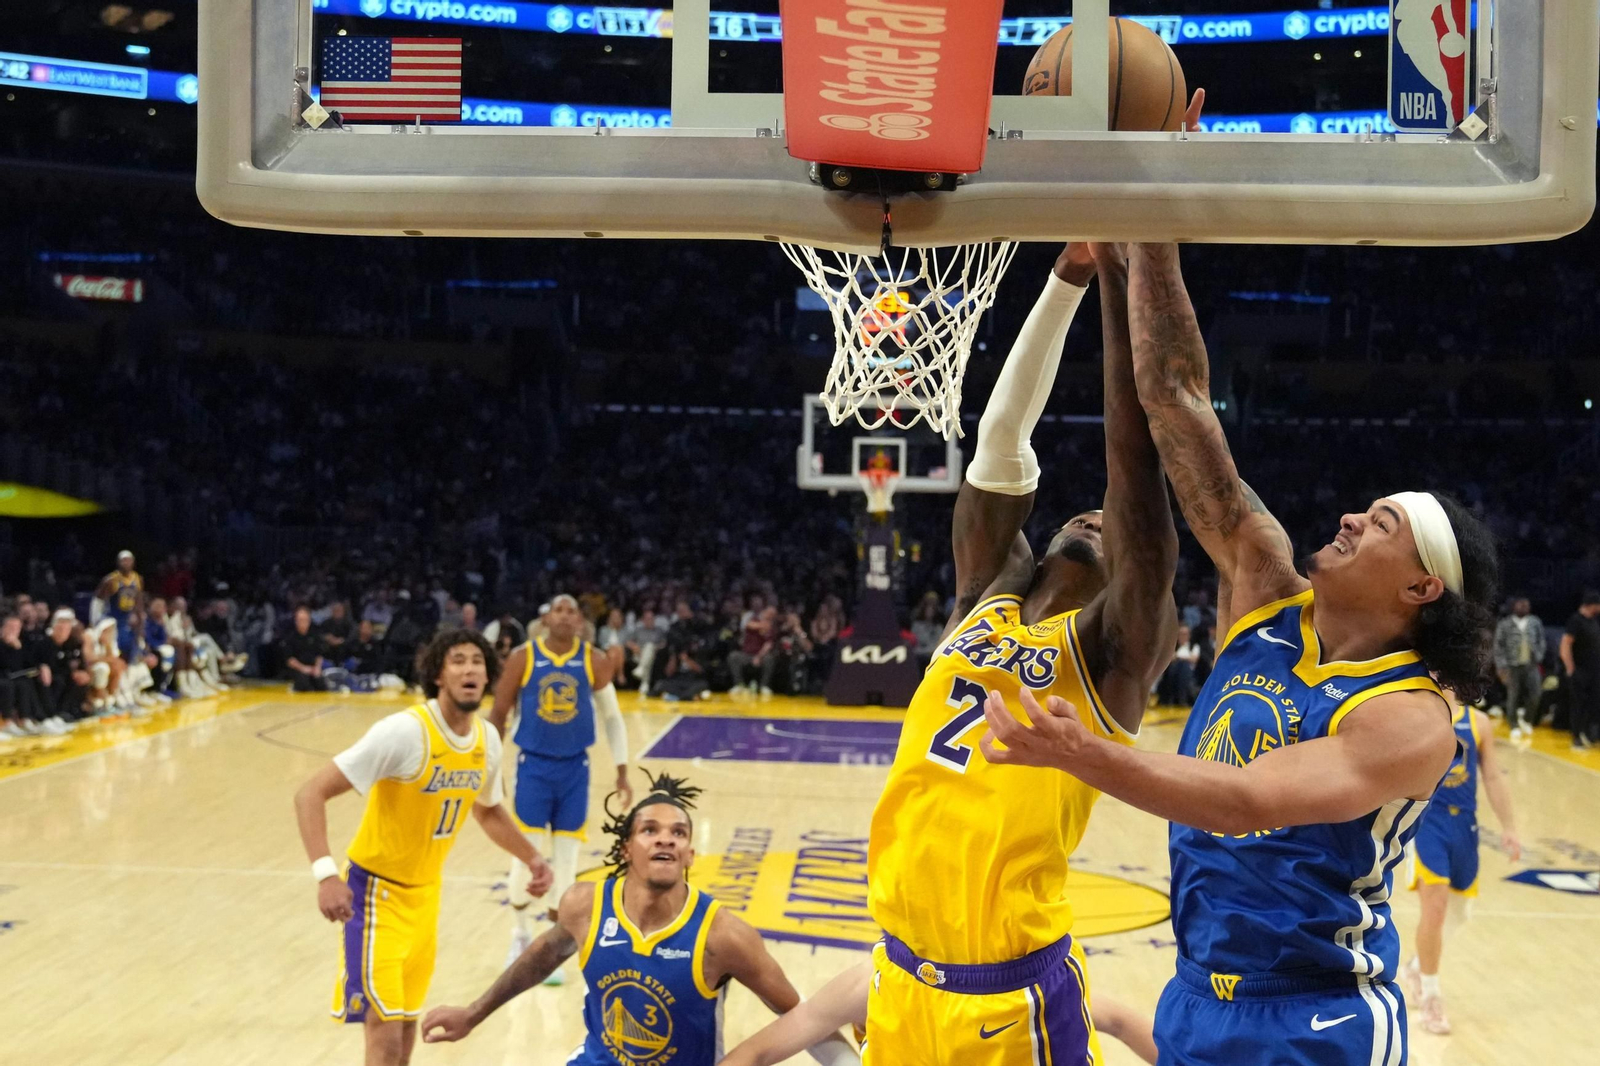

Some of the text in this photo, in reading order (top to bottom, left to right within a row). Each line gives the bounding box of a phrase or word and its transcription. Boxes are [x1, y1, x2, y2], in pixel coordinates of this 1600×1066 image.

[390, 0, 518, 24] crypto.com
[714, 17, 744, 38] 16
[1399, 92, 1437, 121] NBA
[841, 644, 907, 665] KIA
[1222, 673, 1286, 696] GOLDEN
[926, 675, 988, 774] 2
[421, 765, 482, 793] LAKERS
[432, 798, 462, 840] 11
[656, 946, 691, 959] Rakuten
[596, 968, 676, 1006] GOLDEN STATE
[643, 1003, 658, 1027] 3
